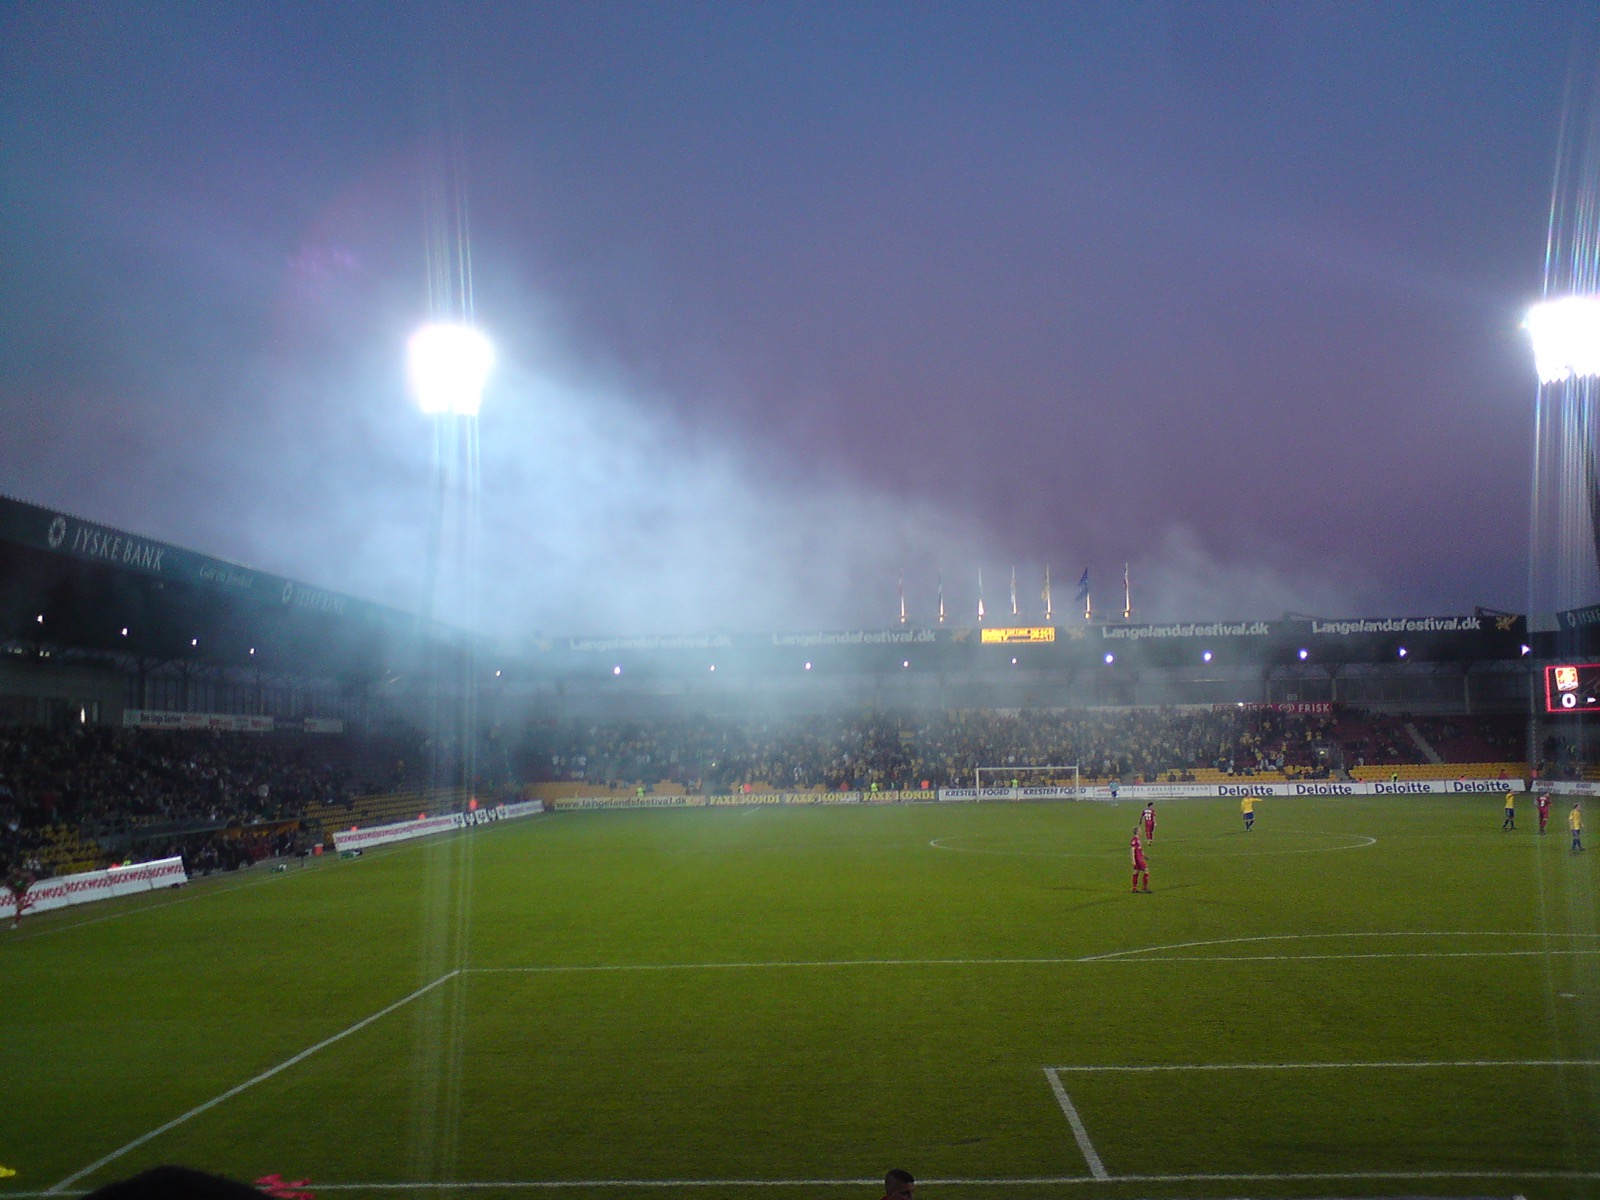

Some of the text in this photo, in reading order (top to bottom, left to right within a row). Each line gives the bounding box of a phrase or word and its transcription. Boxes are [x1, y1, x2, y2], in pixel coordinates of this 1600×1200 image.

[72, 527, 164, 571] JYSKE BANK
[1102, 622, 1269, 639] Langelandsfestival.dk
[1312, 617, 1481, 634] Langelandsfestival.dk
[1562, 693, 1576, 708] 0
[1298, 703, 1330, 713] FRISK
[1218, 785, 1274, 796] Deloitte
[1296, 784, 1352, 795] Deloitte
[1374, 782, 1431, 794] Deloitte
[1454, 781, 1510, 793] Deloitte
[709, 794, 780, 806] FAXE KONDI
[784, 793, 815, 804] FAXE
[863, 790, 936, 802] FAXE KONDI
[555, 796, 688, 810] www.langelandsfestival.dk
